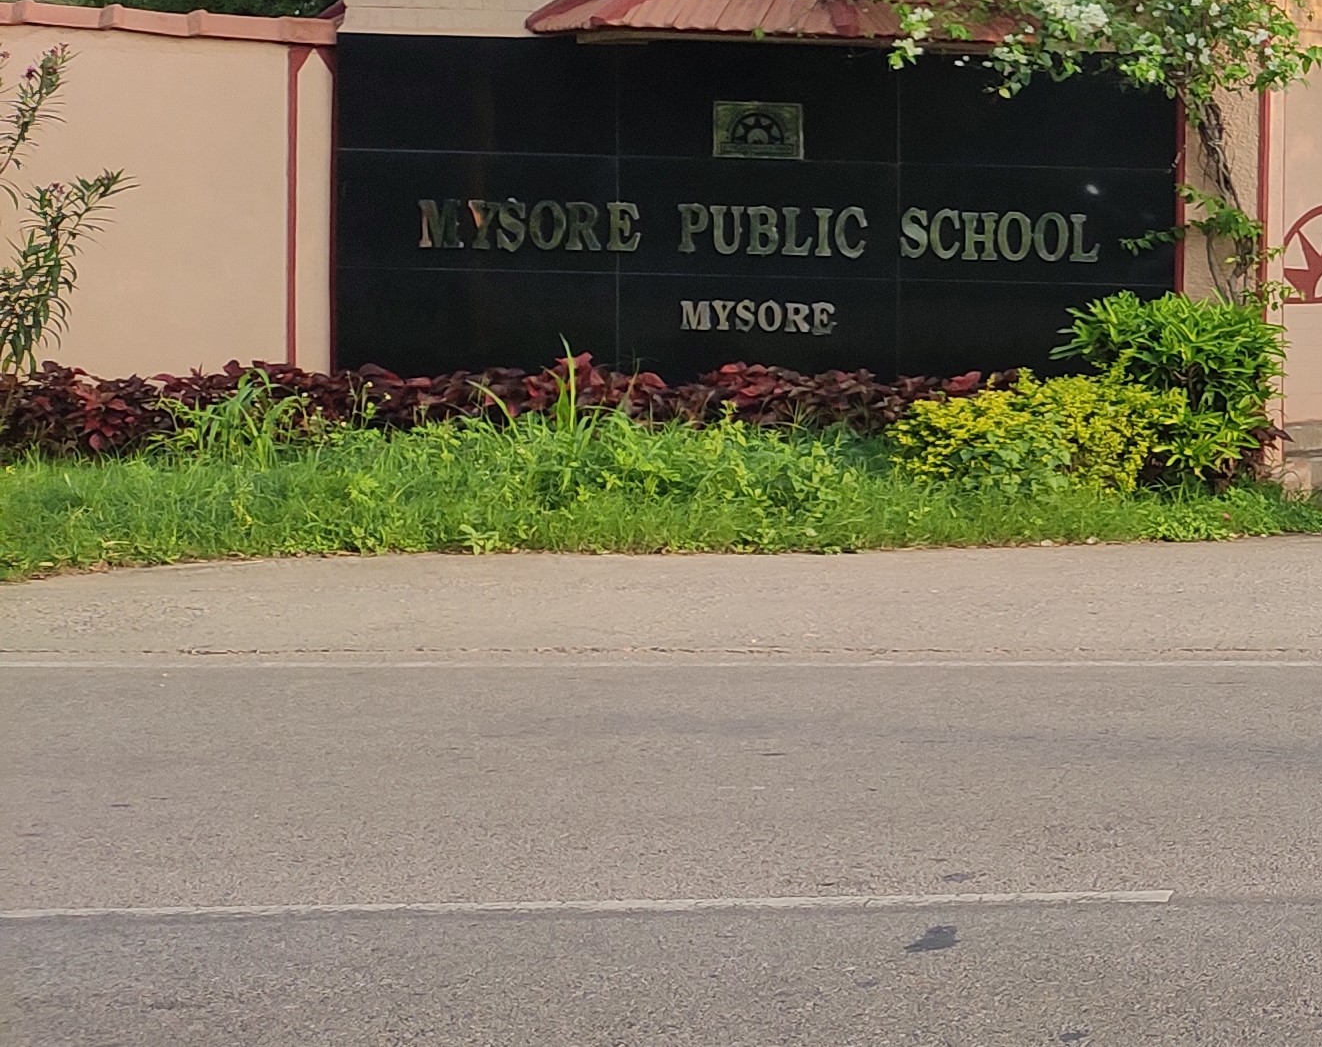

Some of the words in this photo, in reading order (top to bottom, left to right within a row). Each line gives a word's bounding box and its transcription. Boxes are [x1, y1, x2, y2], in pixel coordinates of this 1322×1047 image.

[418, 199, 641, 252] MYSORE
[677, 203, 869, 259] PUBLIC
[900, 207, 1099, 262] SCHOOL
[680, 299, 838, 335] MYSORE
